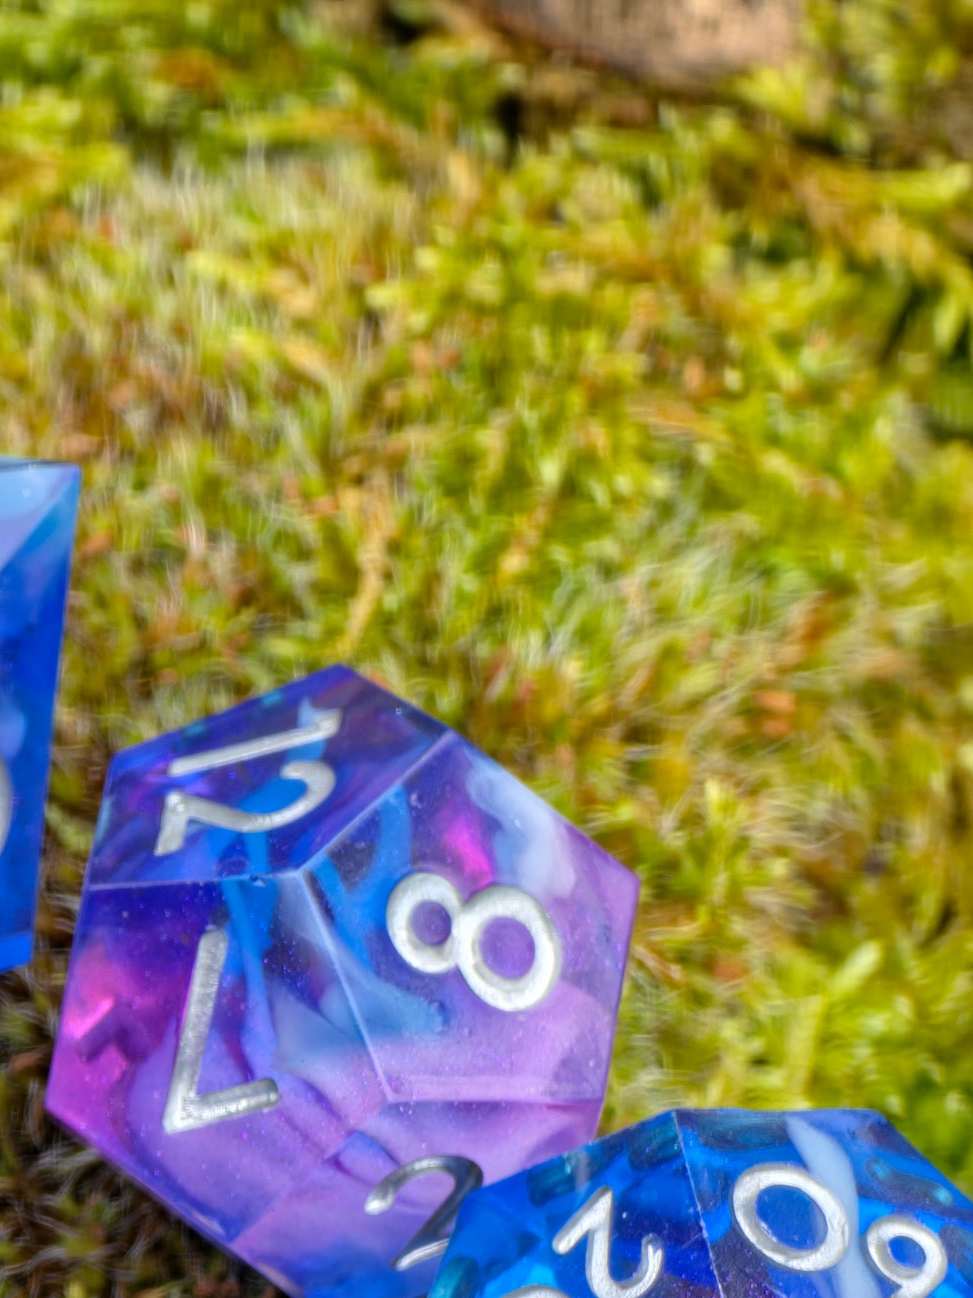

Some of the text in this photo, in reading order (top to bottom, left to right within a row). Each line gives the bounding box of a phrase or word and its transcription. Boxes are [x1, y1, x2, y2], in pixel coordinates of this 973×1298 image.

[154, 709, 342, 857] 12
[386, 871, 562, 1013] 8
[163, 923, 281, 1134] 7
[364, 1154, 484, 1272] 2
